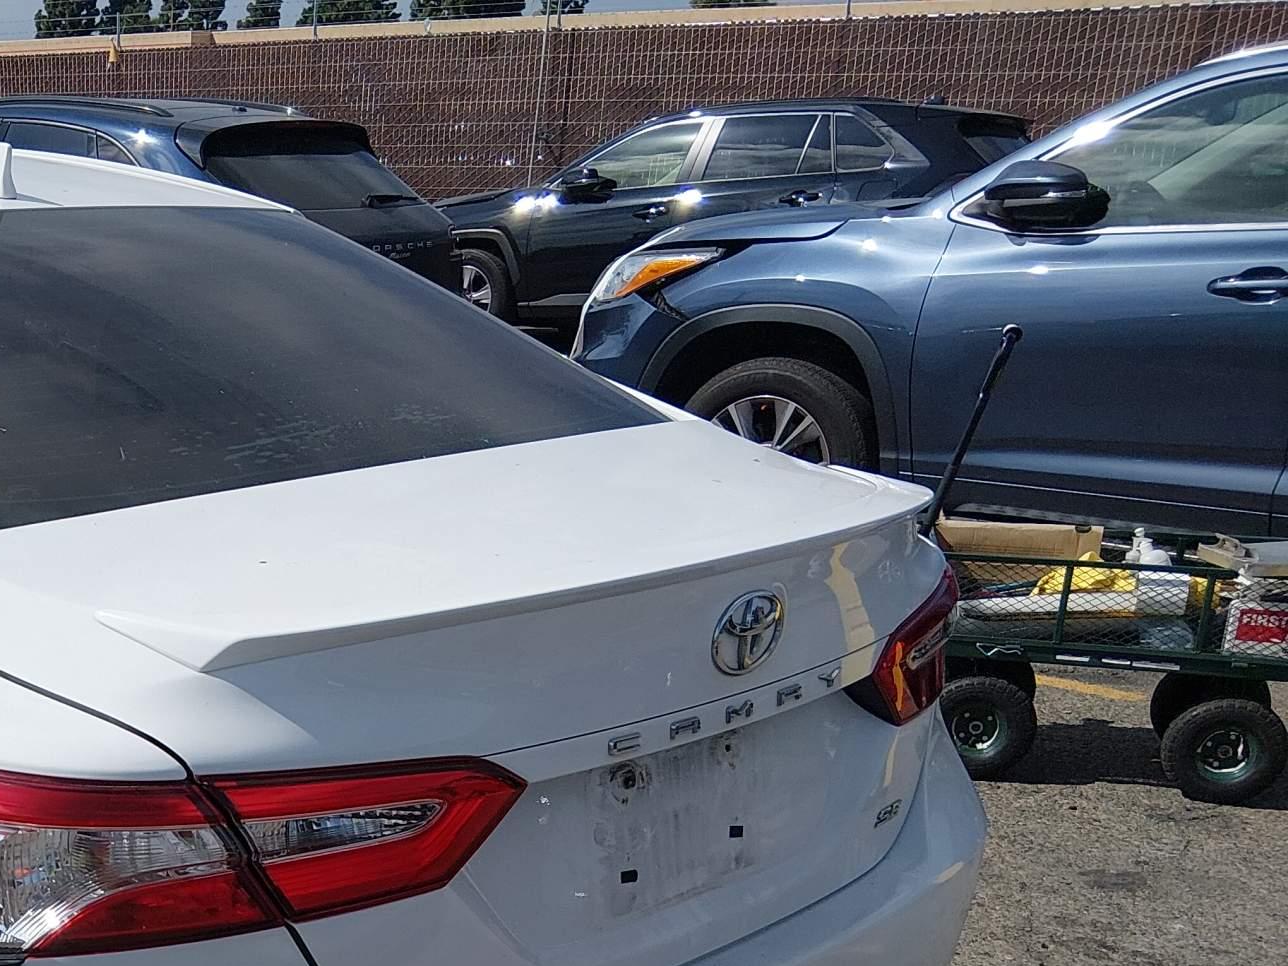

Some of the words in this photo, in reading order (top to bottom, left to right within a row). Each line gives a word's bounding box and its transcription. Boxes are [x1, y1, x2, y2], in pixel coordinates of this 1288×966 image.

[372, 241, 433, 253] ORSCHE
[1241, 612, 1288, 628] FIRST
[607, 666, 842, 756] CAMRY
[874, 799, 903, 829] SE
